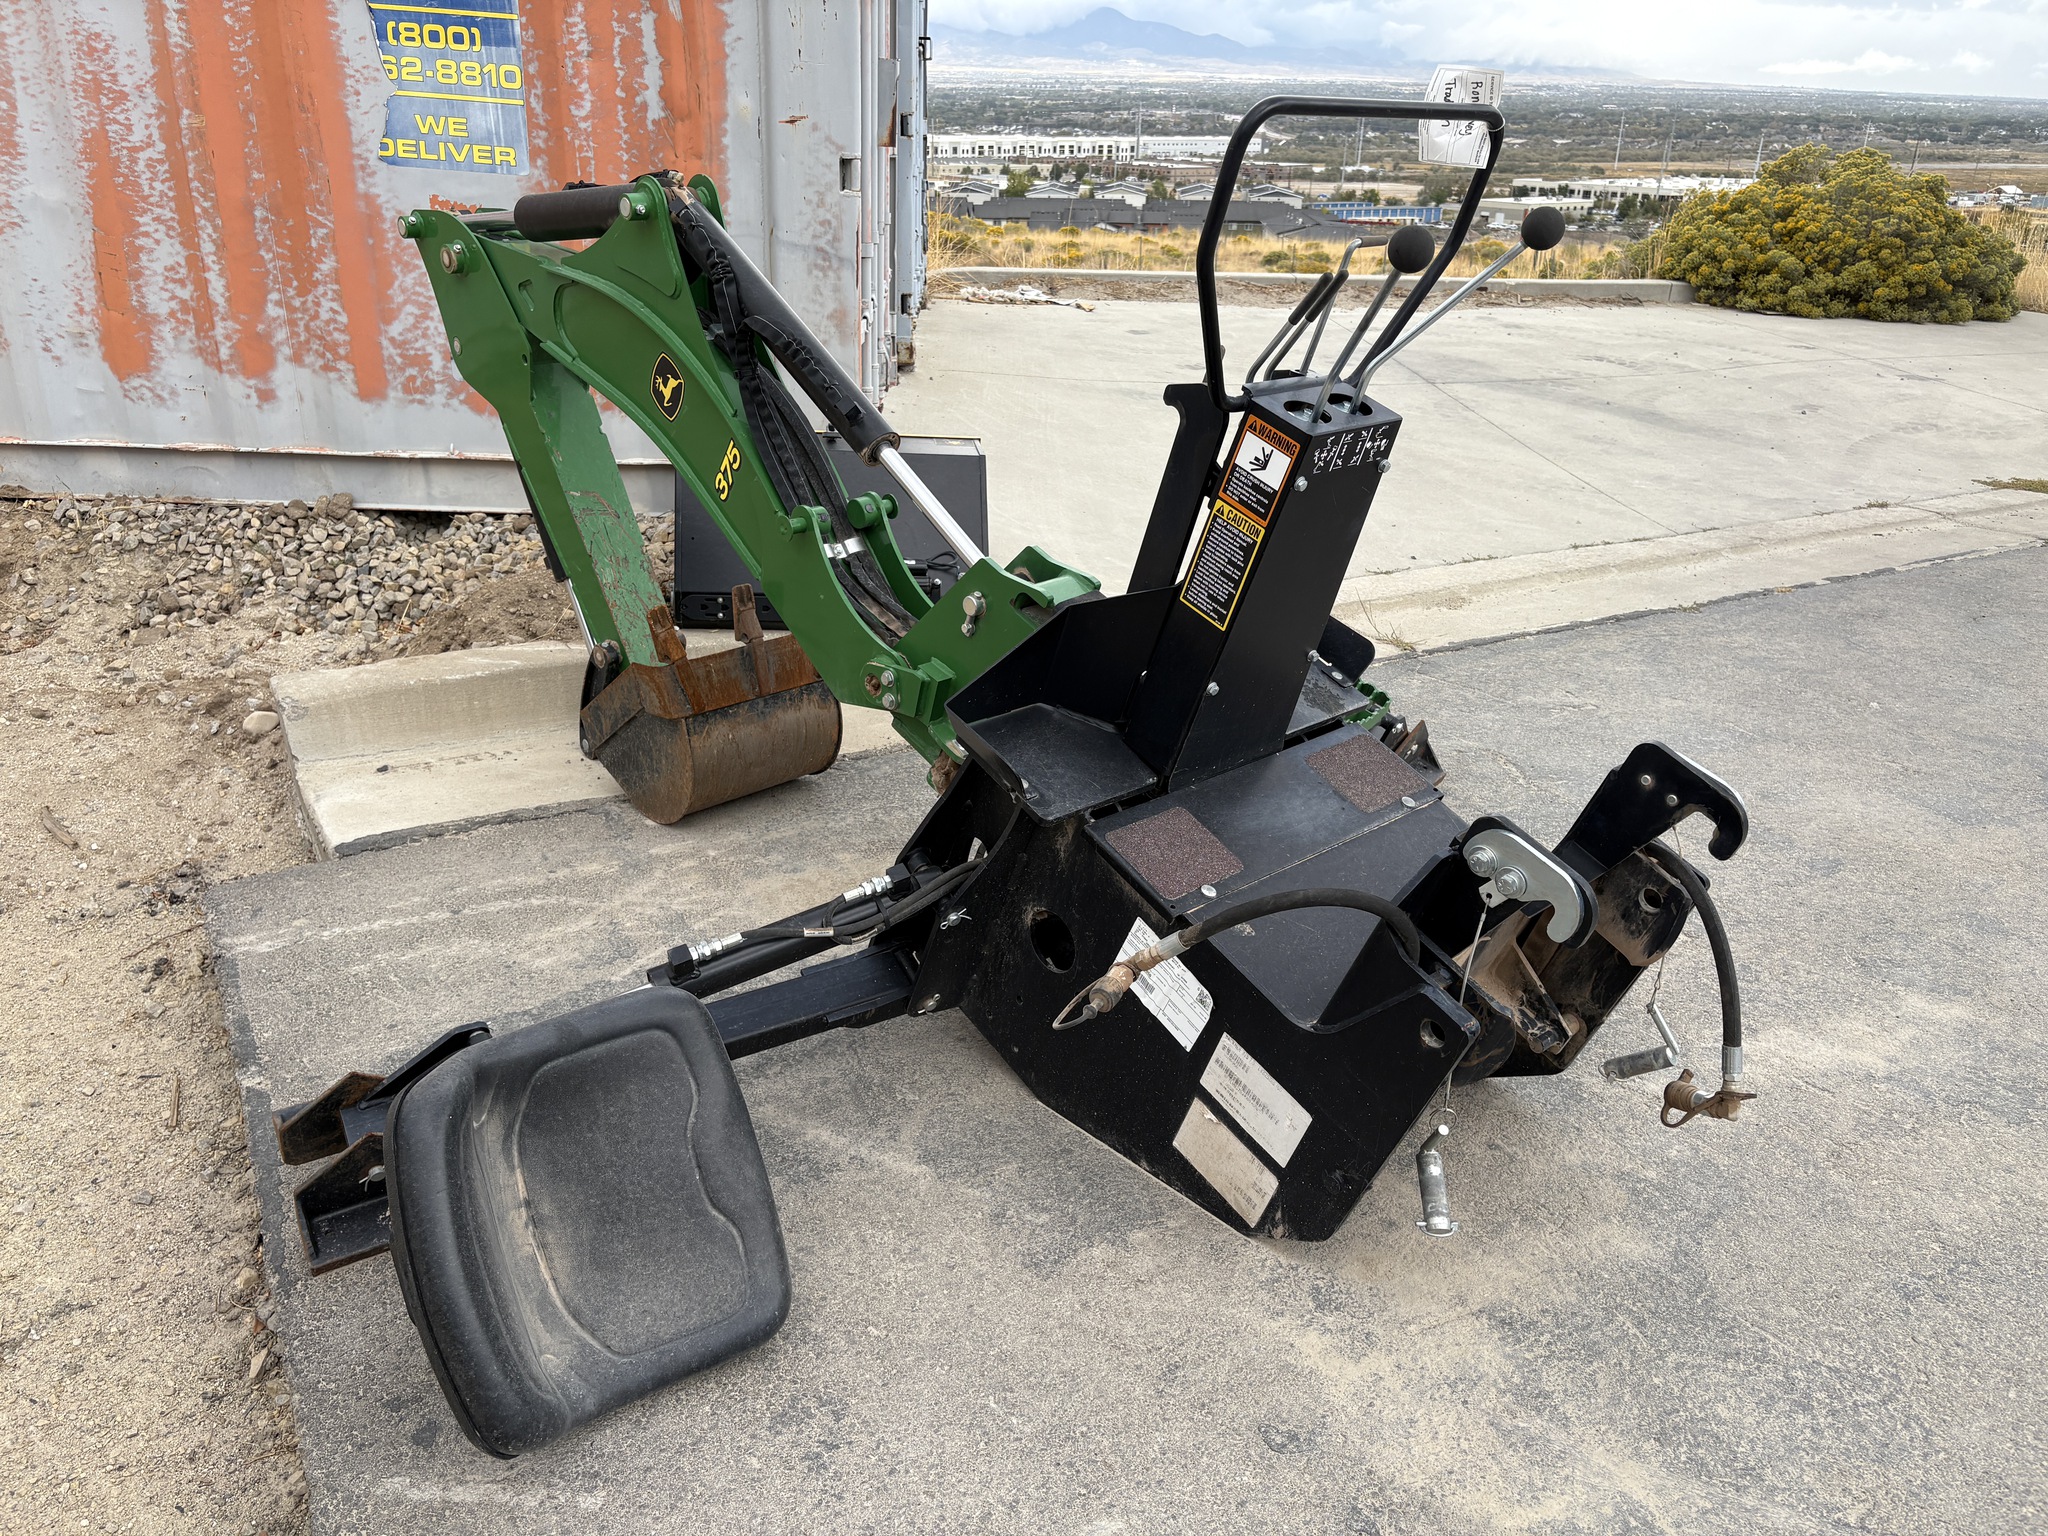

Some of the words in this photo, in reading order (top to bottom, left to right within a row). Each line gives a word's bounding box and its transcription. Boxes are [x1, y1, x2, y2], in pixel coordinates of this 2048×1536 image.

[386, 21, 482, 52] (800)
[414, 114, 469, 138] WE
[379, 137, 517, 167] DELIVER
[1257, 423, 1298, 456] WARNING
[715, 438, 741, 502] 375
[1226, 509, 1262, 540] CAUTION
